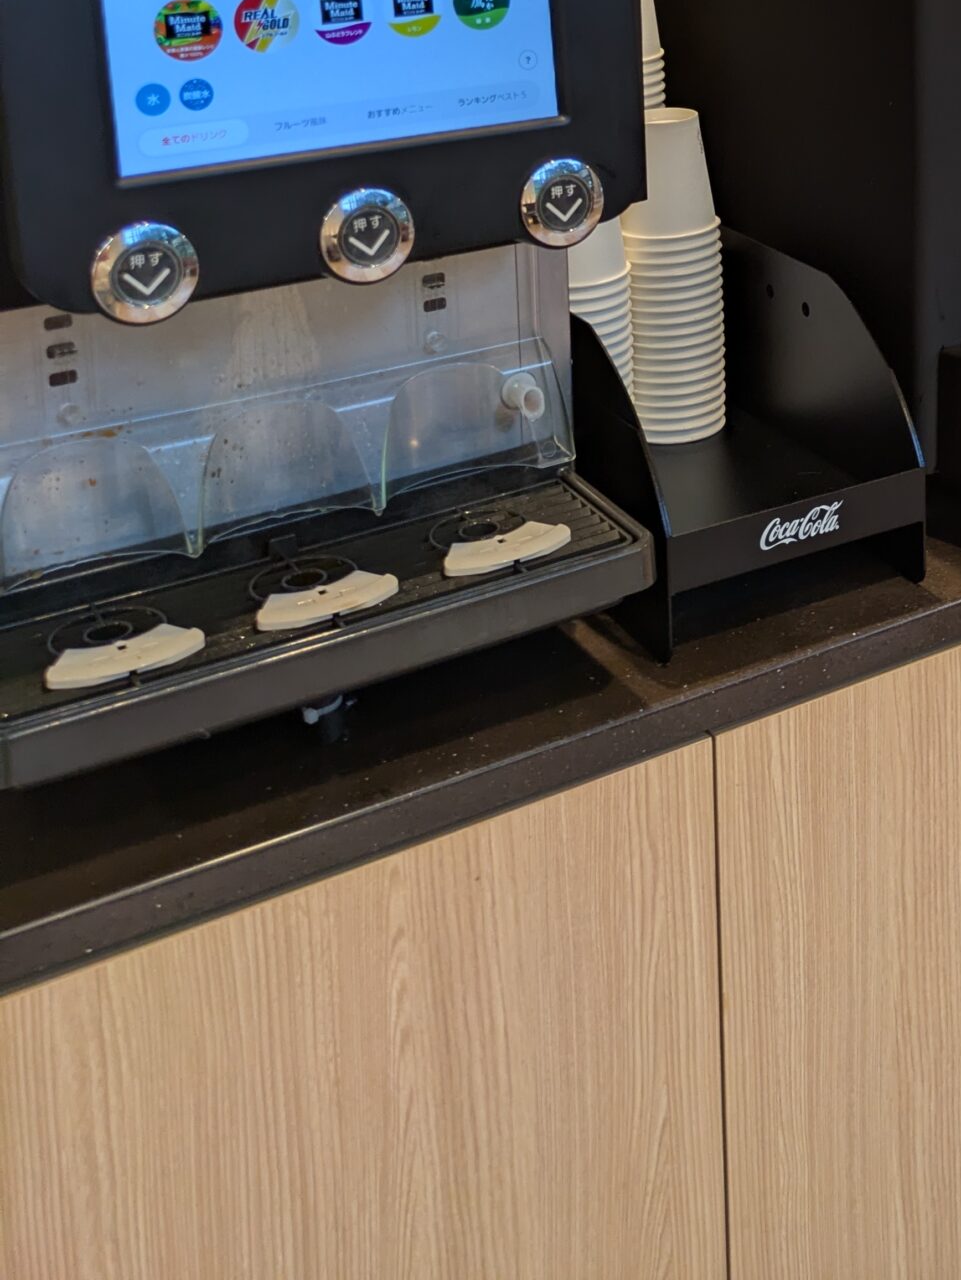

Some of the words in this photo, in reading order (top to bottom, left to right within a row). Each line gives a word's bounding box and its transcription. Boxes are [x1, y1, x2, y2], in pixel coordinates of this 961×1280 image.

[325, 1, 358, 11] Minute
[330, 8, 355, 18] Maid
[401, 1, 425, 11] Maid
[244, 7, 278, 21] REAL
[262, 17, 290, 31] GOLD
[147, 92, 160, 107] 水
[367, 104, 433, 119] おすすめメニュー
[162, 129, 228, 146] 全てのドリンク
[550, 183, 578, 199] 押す
[352, 215, 384, 232] 押す
[129, 252, 164, 268] 押す
[760, 500, 844, 550] Coca-Cola
